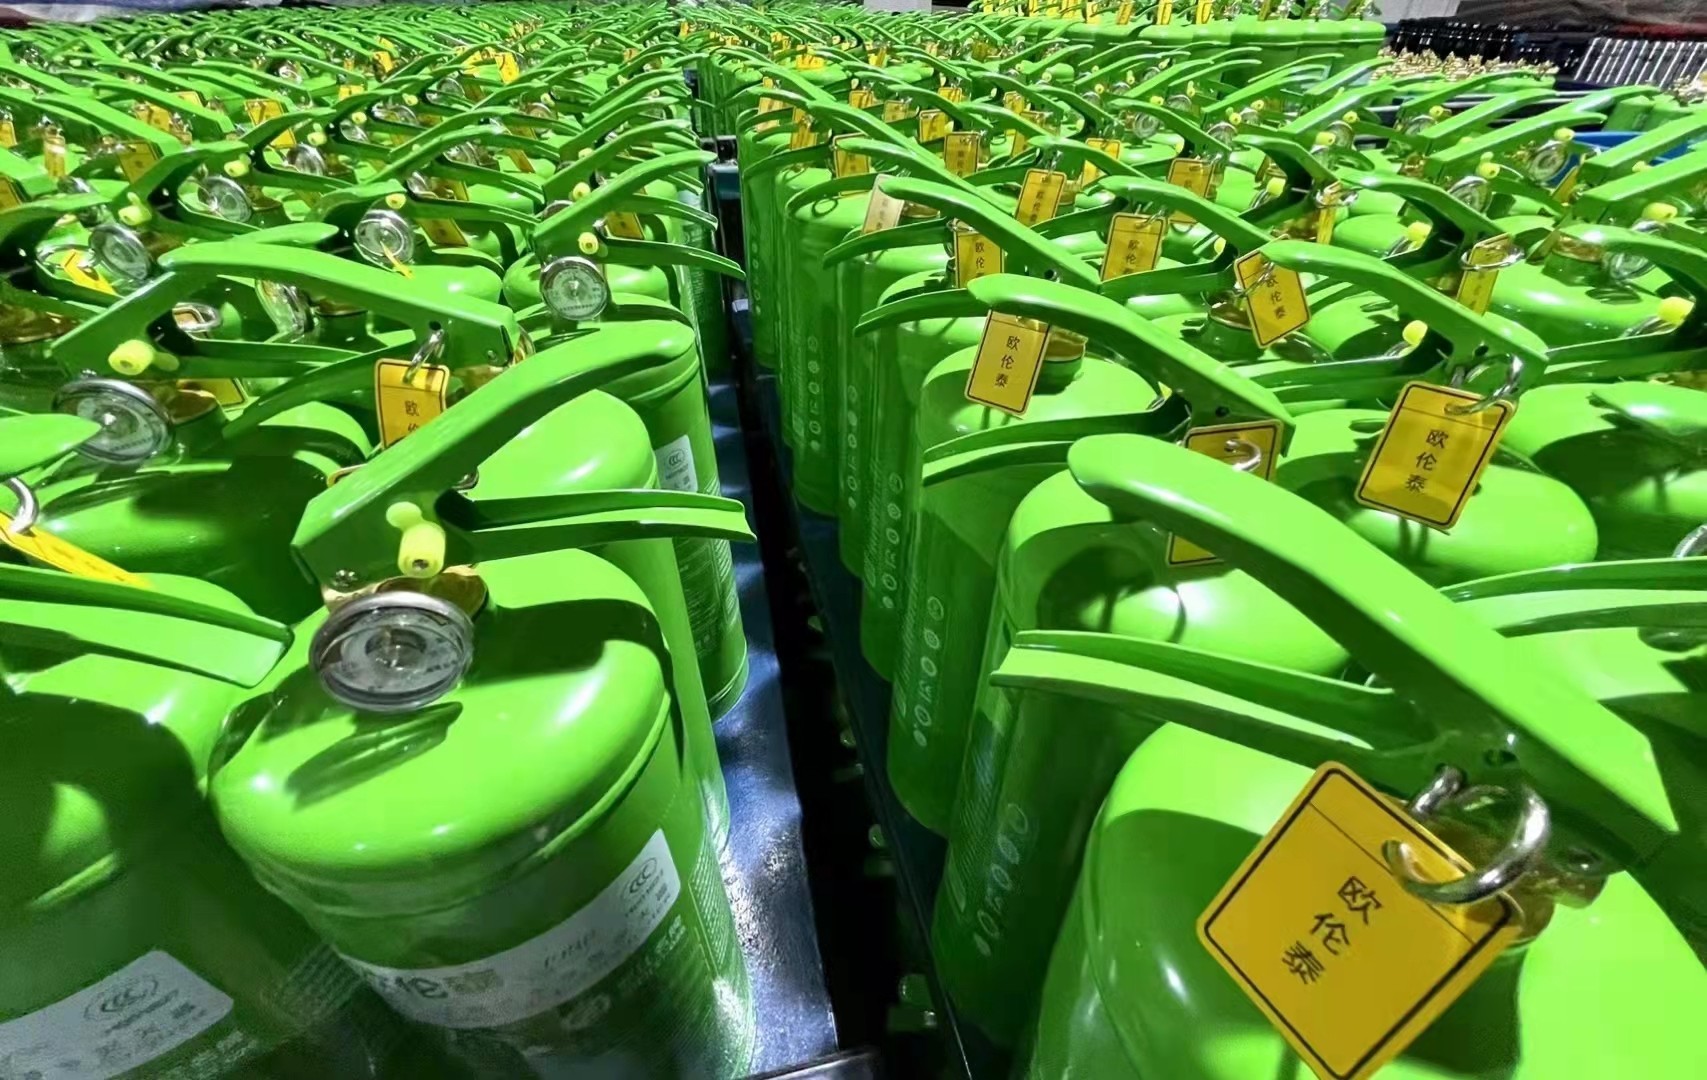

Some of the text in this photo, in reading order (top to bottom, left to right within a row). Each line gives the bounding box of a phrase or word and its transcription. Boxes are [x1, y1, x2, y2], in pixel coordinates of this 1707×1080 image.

[994, 335, 1020, 388] 欧伦泰
[1405, 428, 1449, 493] 欧伦泰
[1282, 876, 1382, 985] 欧伦泰
